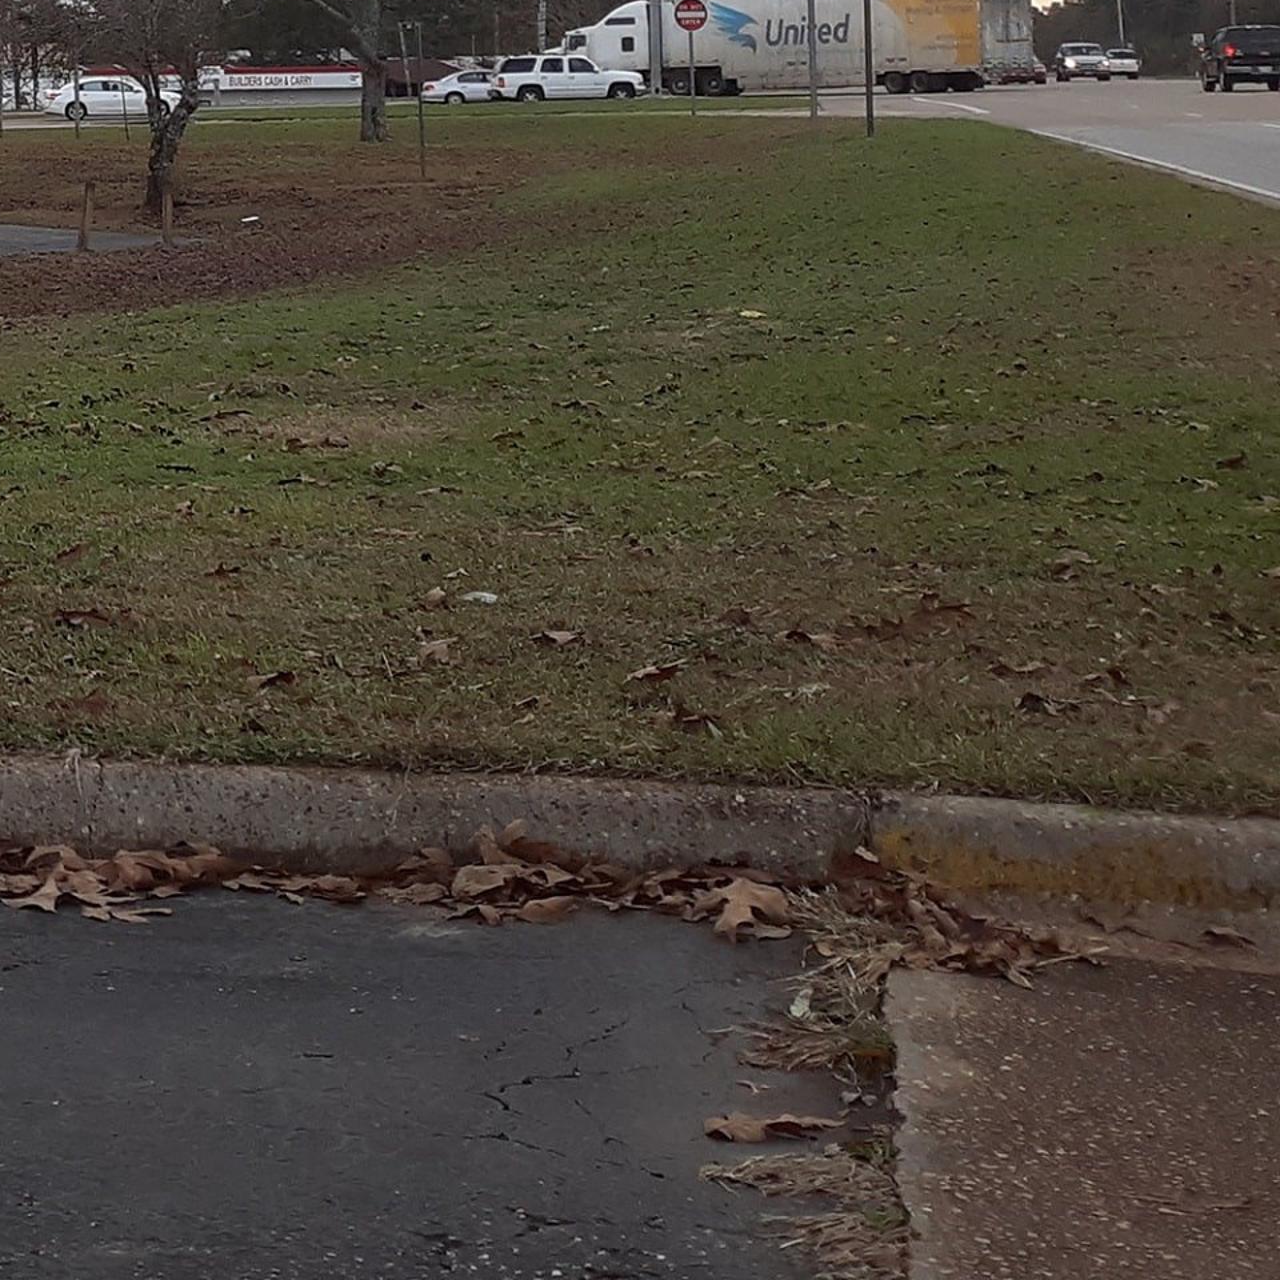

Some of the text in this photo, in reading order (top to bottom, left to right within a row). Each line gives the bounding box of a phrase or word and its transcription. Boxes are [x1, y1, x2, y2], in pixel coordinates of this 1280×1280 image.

[228, 76, 262, 87] BUILDERS
[264, 76, 283, 86] CASH
[290, 75, 313, 86] CARRY
